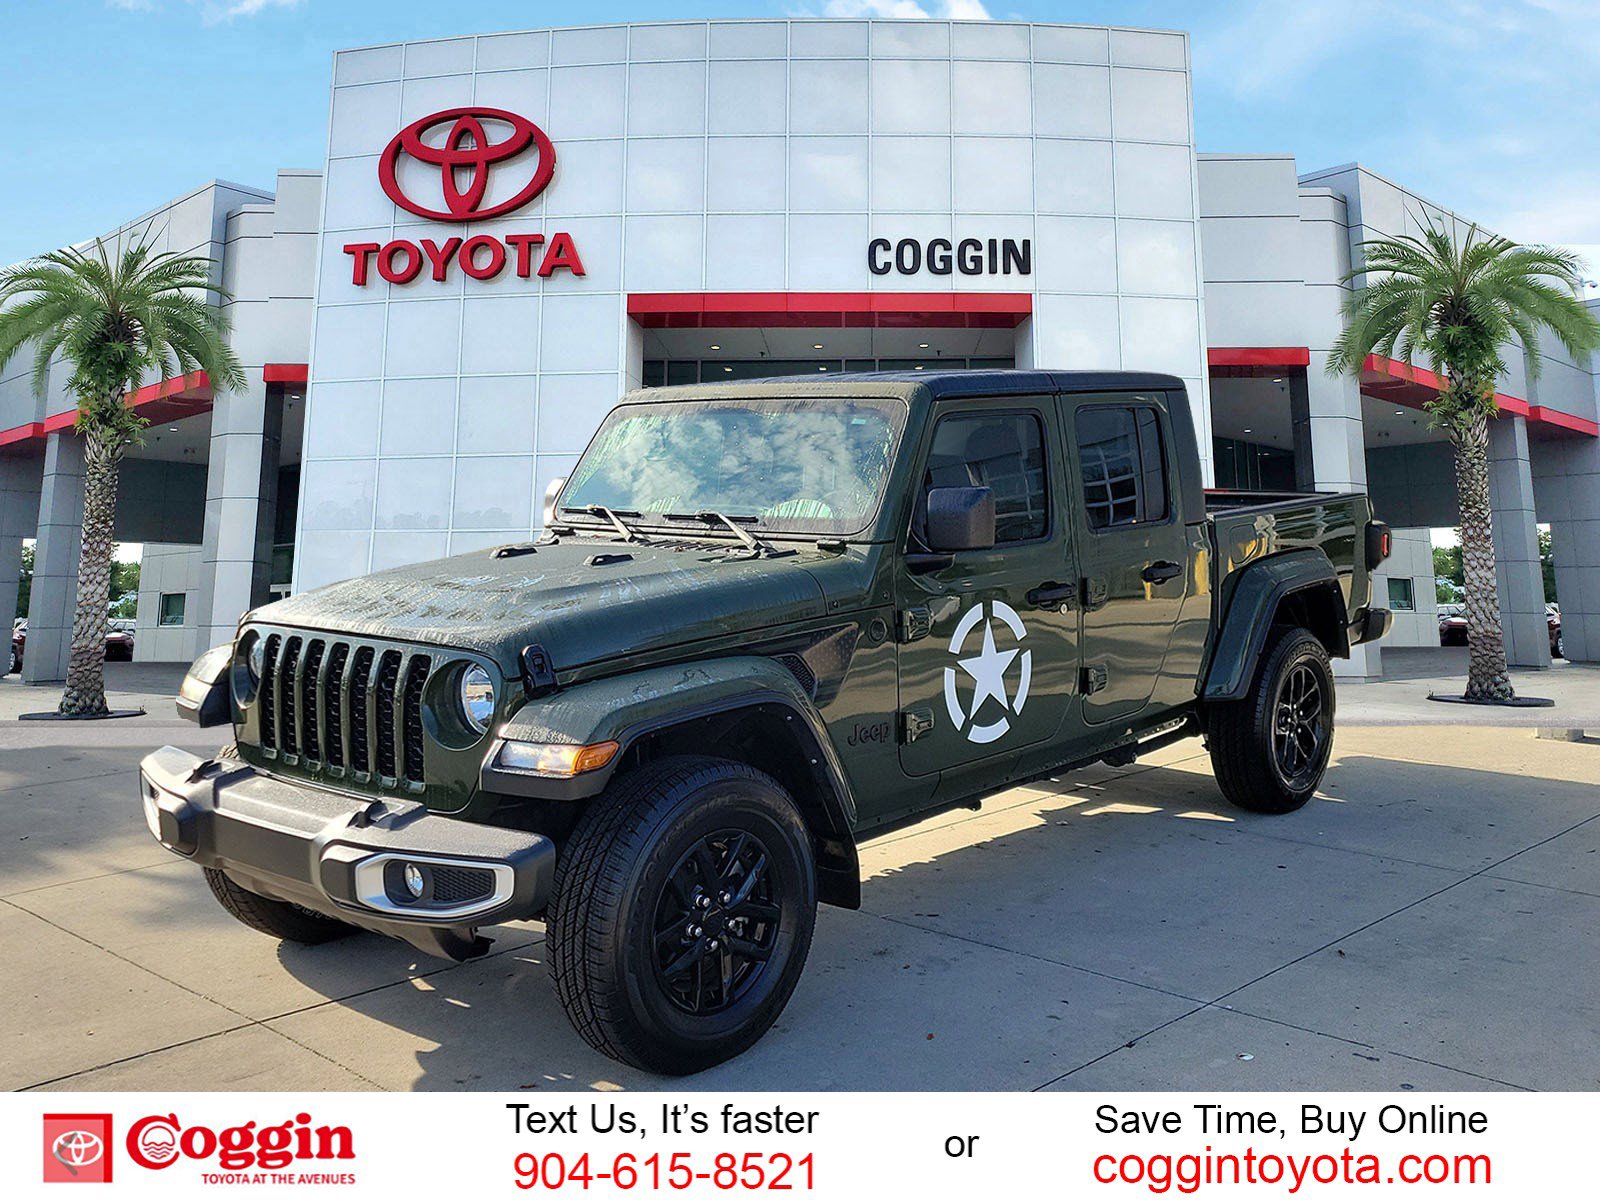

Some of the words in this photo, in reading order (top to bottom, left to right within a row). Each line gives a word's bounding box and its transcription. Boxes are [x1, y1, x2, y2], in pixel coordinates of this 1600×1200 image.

[343, 232, 586, 286] TOYOTA
[868, 238, 1032, 276] COGGIN
[847, 722, 889, 746] Jeep
